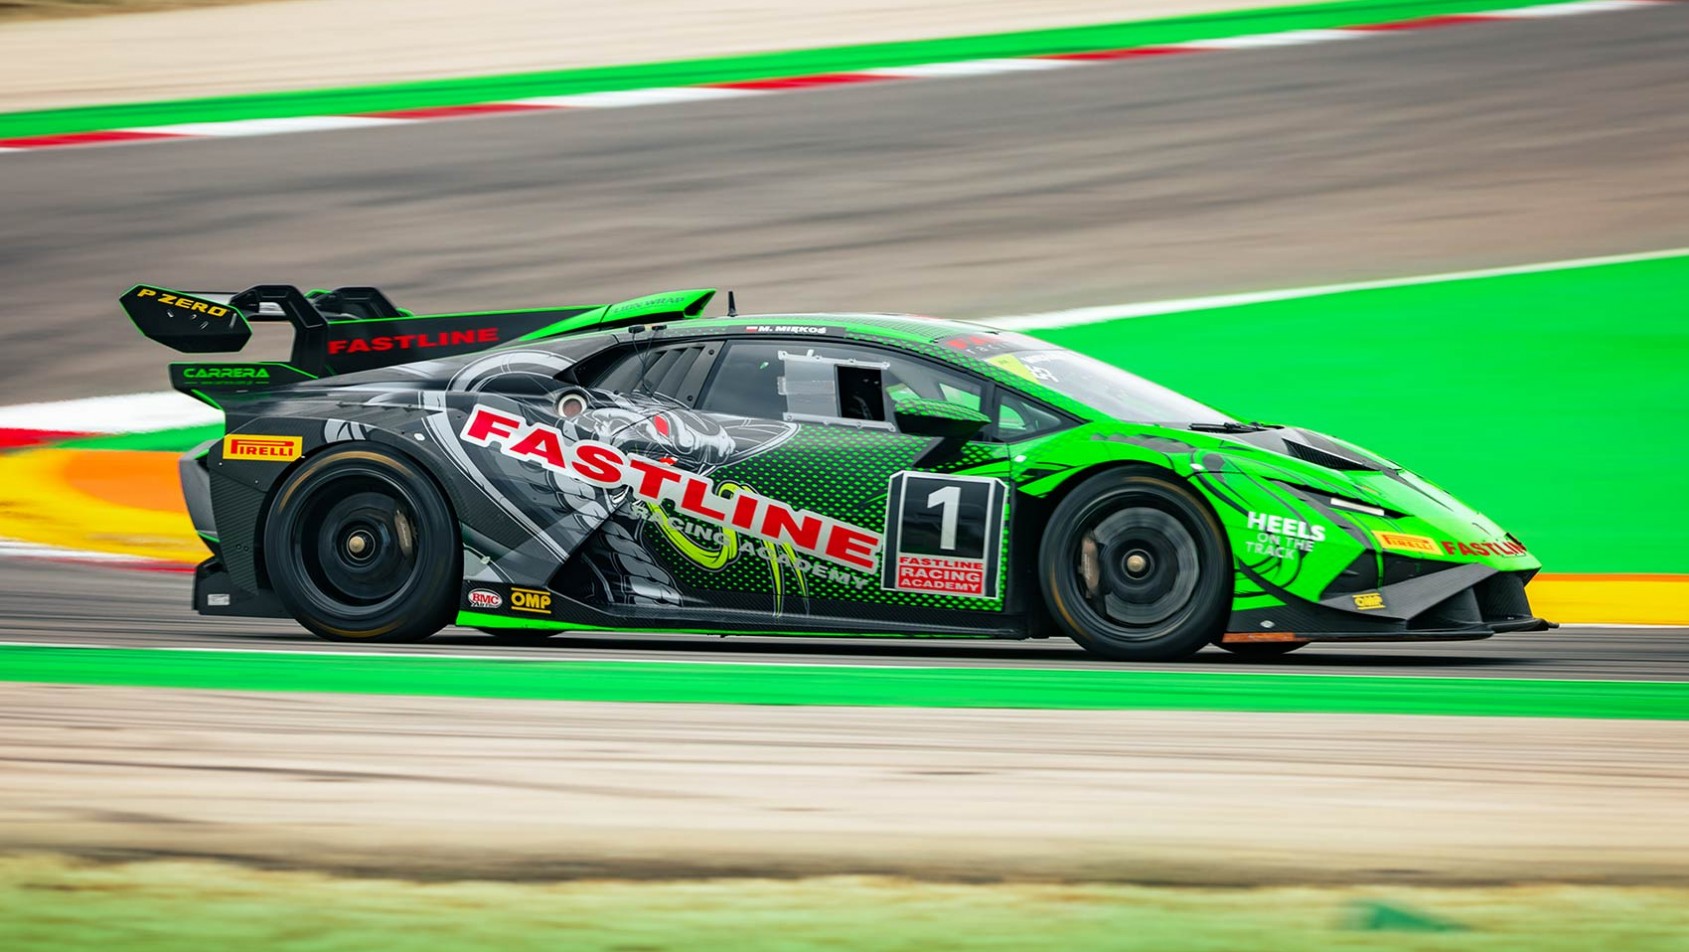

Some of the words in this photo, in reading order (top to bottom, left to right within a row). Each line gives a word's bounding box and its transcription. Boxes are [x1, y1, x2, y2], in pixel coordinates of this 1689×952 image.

[137, 288, 156, 297] P
[158, 293, 228, 317] ZERO
[327, 327, 499, 355] FASTLINE
[183, 368, 270, 378] CARRERA
[230, 439, 294, 457] PIRELLI
[466, 409, 880, 570] FASTLINE
[927, 486, 961, 550] 1
[1247, 511, 1326, 542] HEELS
[633, 503, 731, 547] RACING
[739, 542, 869, 590] ACADEMY
[1246, 541, 1295, 560] TRACK
[1257, 532, 1280, 546] ON
[1285, 537, 1315, 552] THE
[1382, 535, 1434, 551] PIRELLI
[899, 557, 983, 570] FASTLINE
[901, 567, 980, 582] RACING
[901, 579, 979, 592] ACADEMY
[472, 593, 499, 605] BMC
[511, 591, 551, 609] OMP
